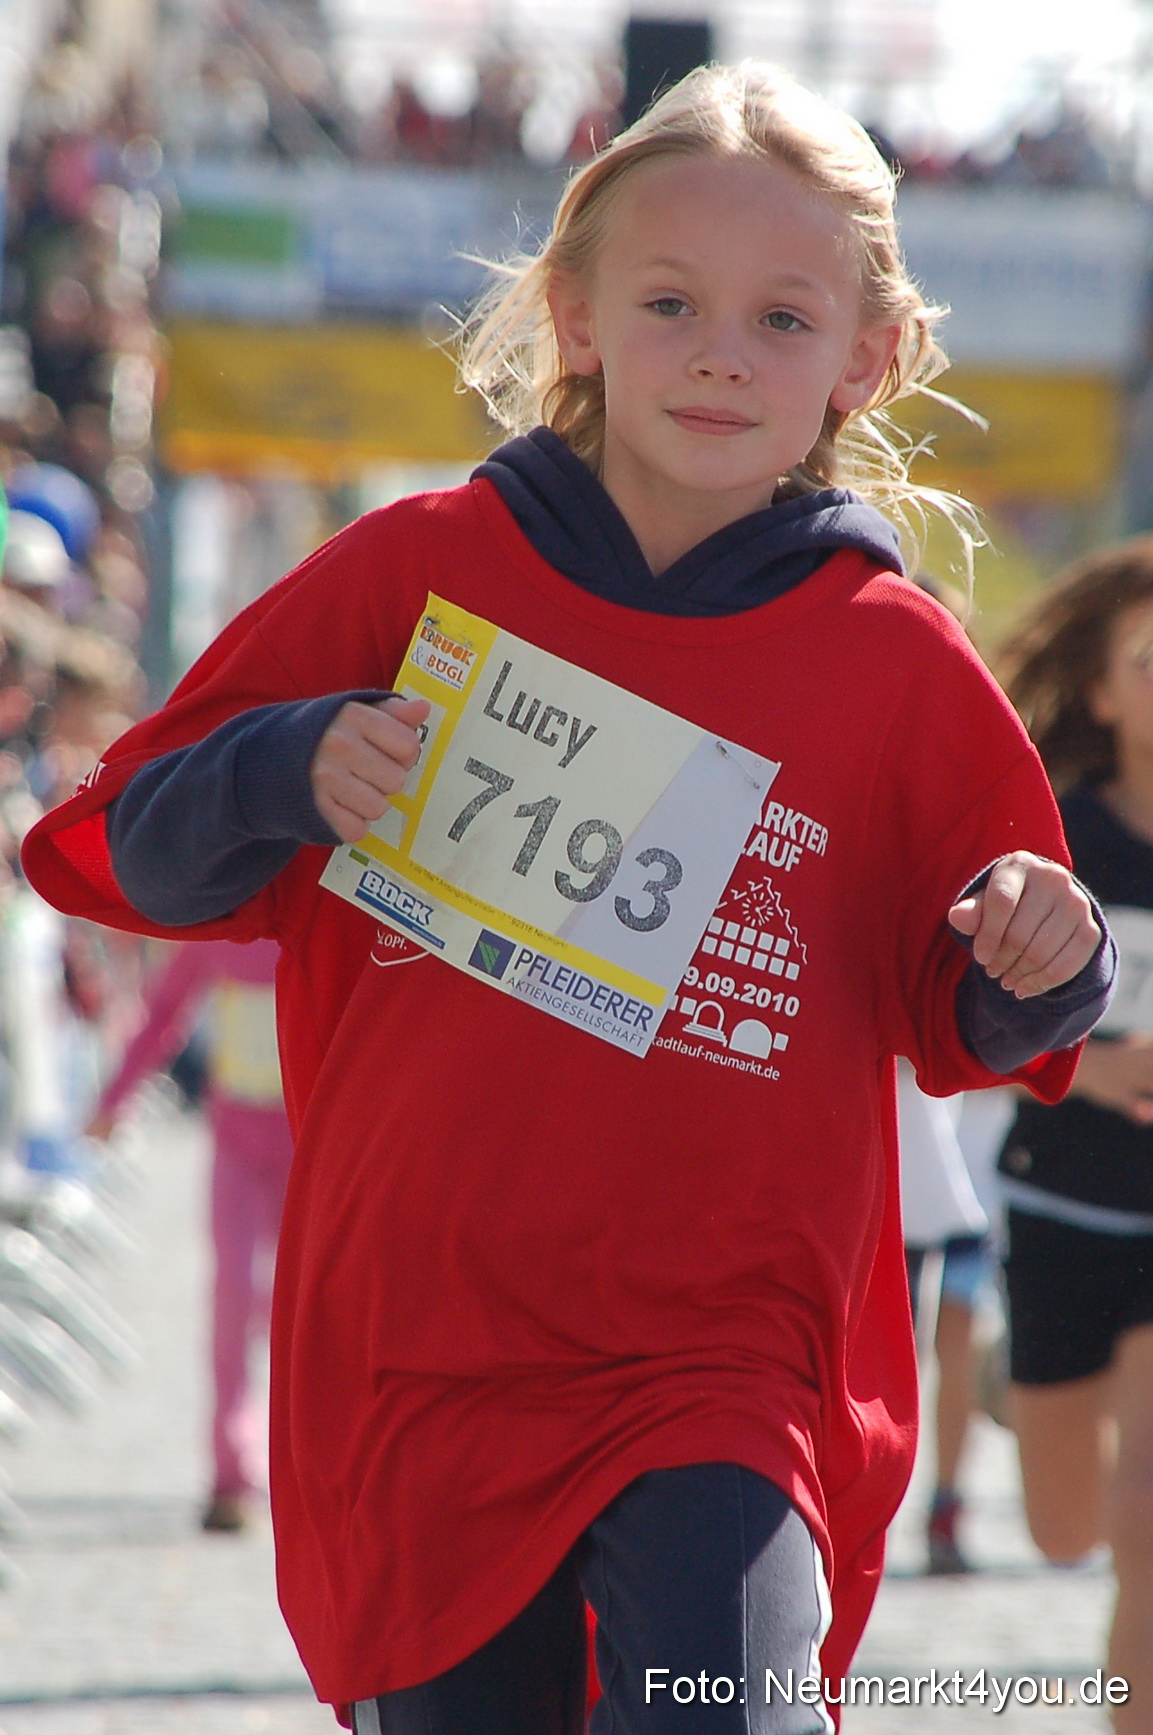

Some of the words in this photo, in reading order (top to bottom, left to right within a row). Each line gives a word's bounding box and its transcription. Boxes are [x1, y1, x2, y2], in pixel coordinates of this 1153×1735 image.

[411, 645, 424, 665] &
[447, 757, 684, 932] 7193
[742, 831, 803, 872] AUF
[755, 801, 829, 857] RKTER
[359, 870, 434, 926] BOCK
[506, 977, 645, 1048] AKTIENGESELLSCHAFT
[514, 948, 654, 1034] PFLEIDERER
[683, 966, 800, 1017] 9.09.2010
[652, 1035, 781, 1080] tadtlauf-neumarkt.de
